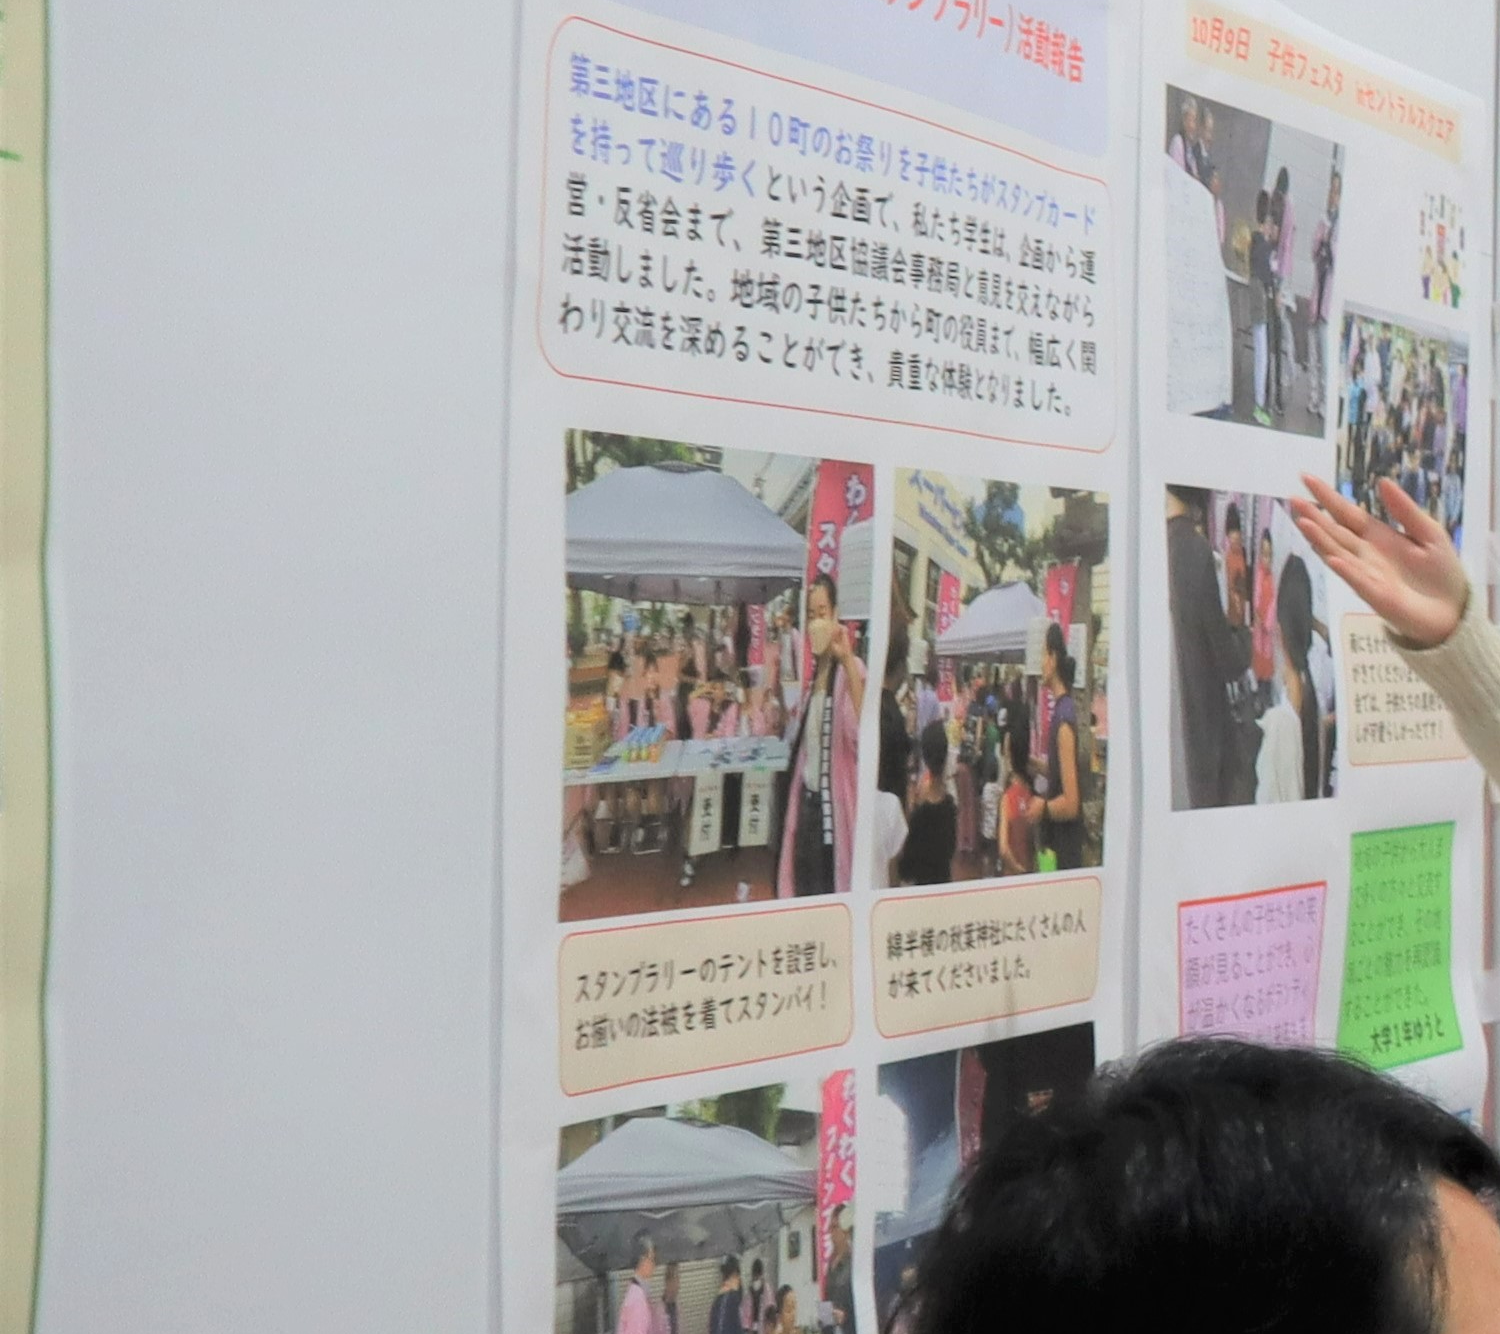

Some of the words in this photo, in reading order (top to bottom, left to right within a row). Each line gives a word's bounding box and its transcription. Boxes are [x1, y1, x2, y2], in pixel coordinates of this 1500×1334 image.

[569, 114, 1098, 286] を持って巡り歩くという企画で、私たち学生は、企画から運
[557, 294, 1073, 419] わり交流を深めることができ、貴重な体験となりました。
[561, 231, 1099, 377] 活動しました。地域の子供たちから町の役員まで、幅広く関
